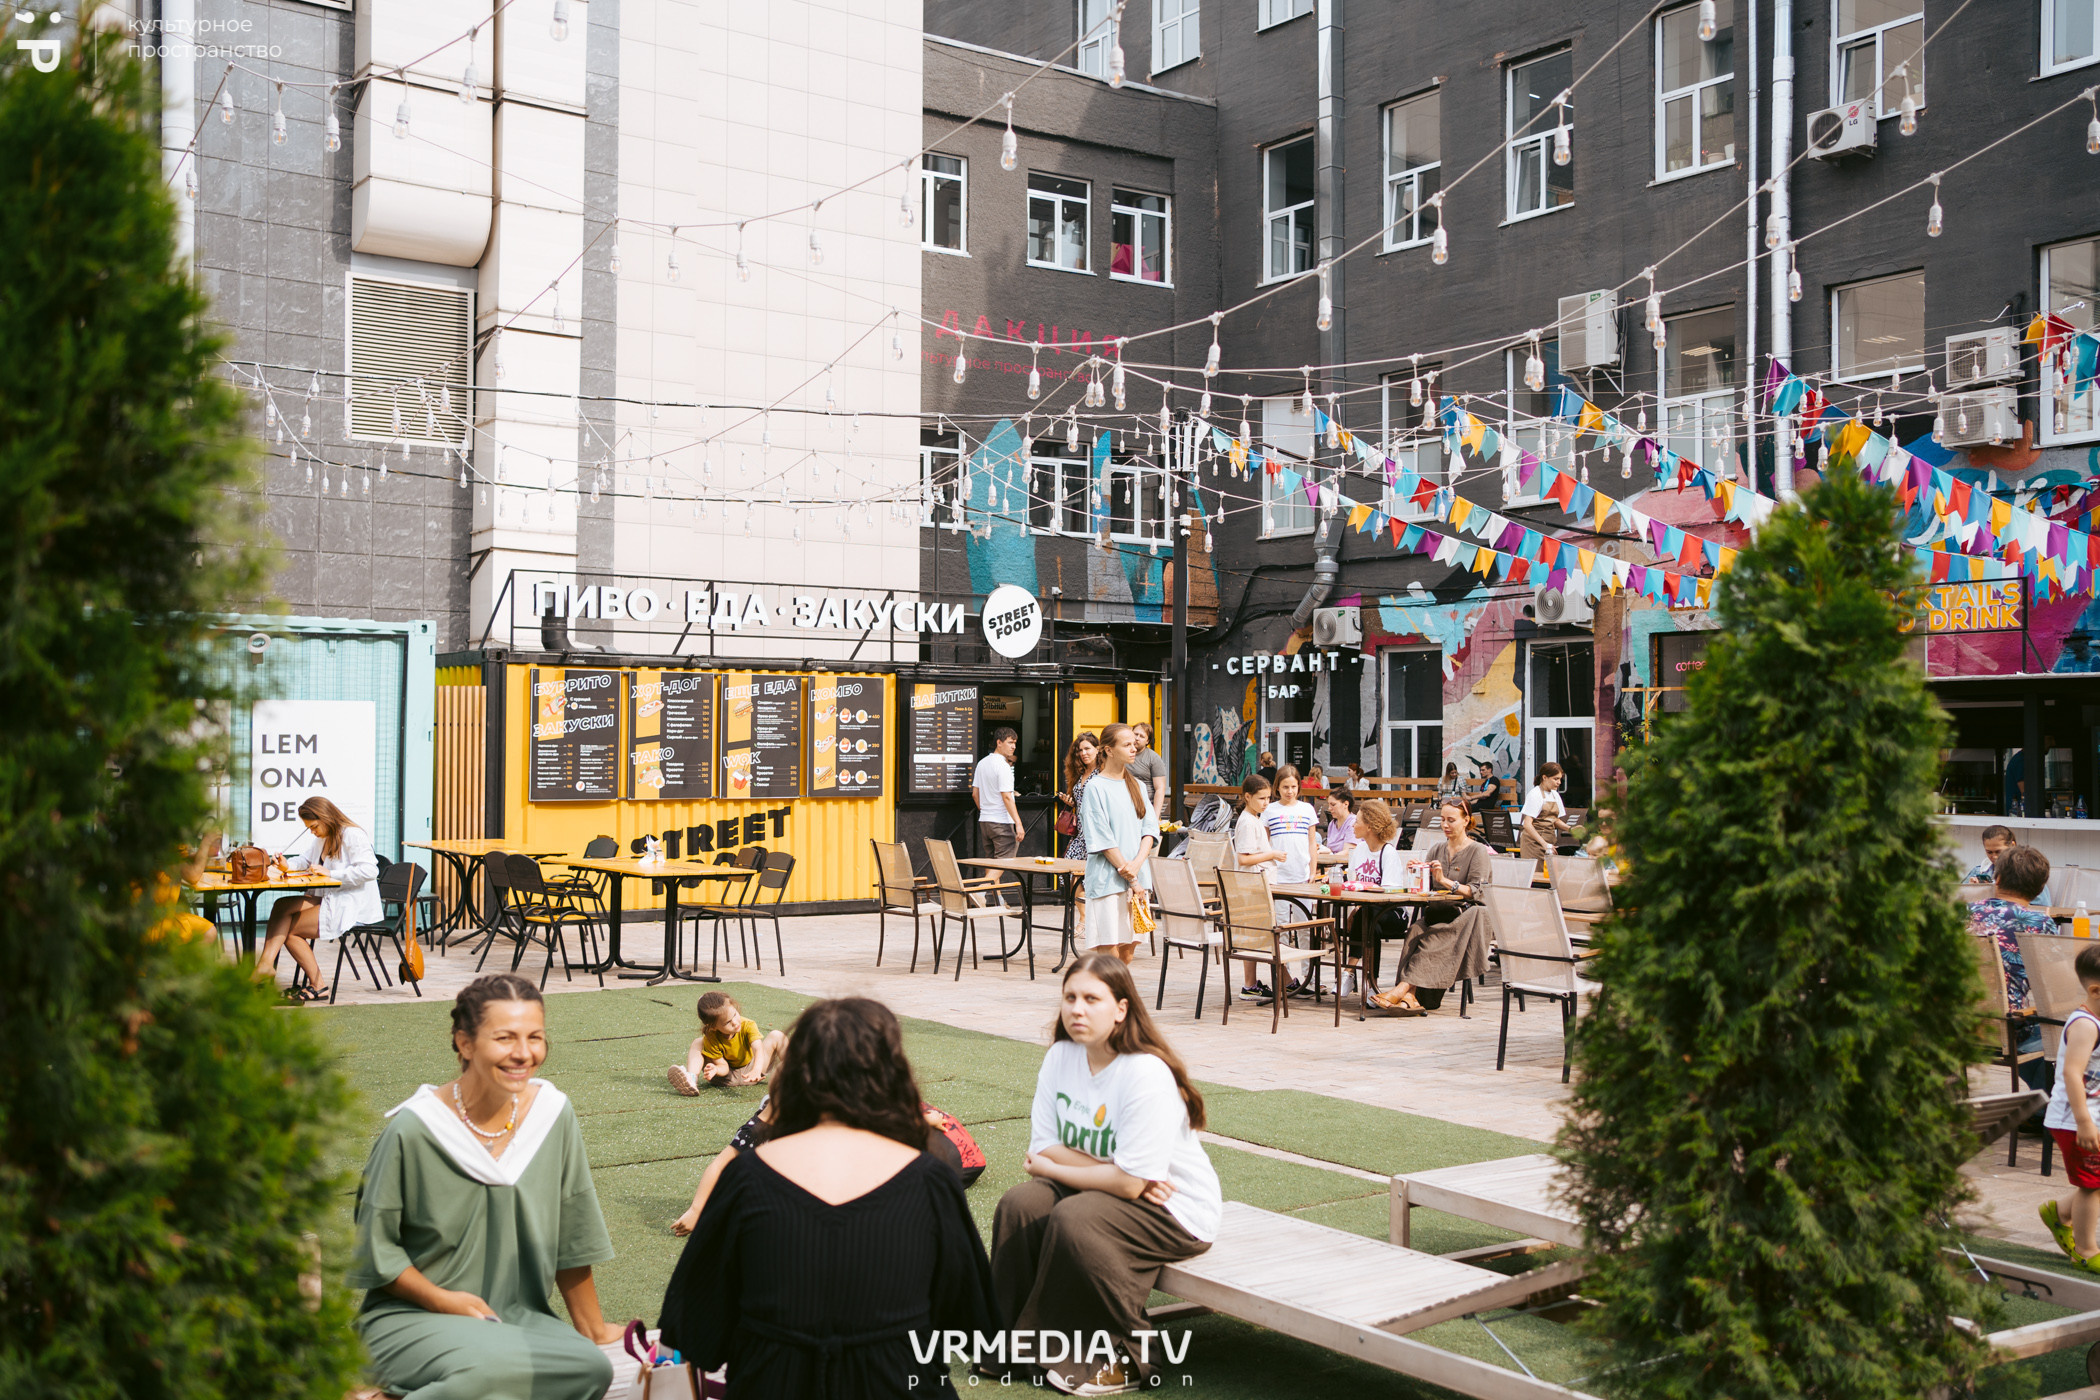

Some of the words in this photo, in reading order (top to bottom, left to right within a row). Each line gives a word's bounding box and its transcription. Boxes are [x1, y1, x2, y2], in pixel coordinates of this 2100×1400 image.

[921, 309, 1119, 358] ДАКЦИЯ
[1880, 583, 2021, 610] OCKTAILS
[534, 583, 660, 621] ПИВО
[685, 590, 772, 631] ЕДА
[792, 596, 965, 634] ЗАКУСКИ
[988, 602, 1035, 629] STREET
[1928, 605, 2021, 631] DRINK
[996, 617, 1031, 640] FOOD
[1226, 651, 1340, 675] СЕРВАНТ
[534, 674, 612, 697] БУРРИТО
[631, 677, 702, 699] ХОТ-ДОГ
[725, 684, 760, 700] ЕЩЕ
[764, 679, 797, 695] ЕДА
[811, 683, 863, 701] КОМБО
[1268, 685, 1300, 699] БАР
[911, 687, 977, 708] НАПИТКИ
[533, 714, 614, 737] ЗАКУСКИ
[261, 734, 317, 754] LEM
[631, 747, 674, 765] ТАКО
[723, 751, 761, 768] WOK
[260, 767, 327, 788] ONA
[261, 802, 297, 822] DE
[631, 806, 791, 859] STREET
